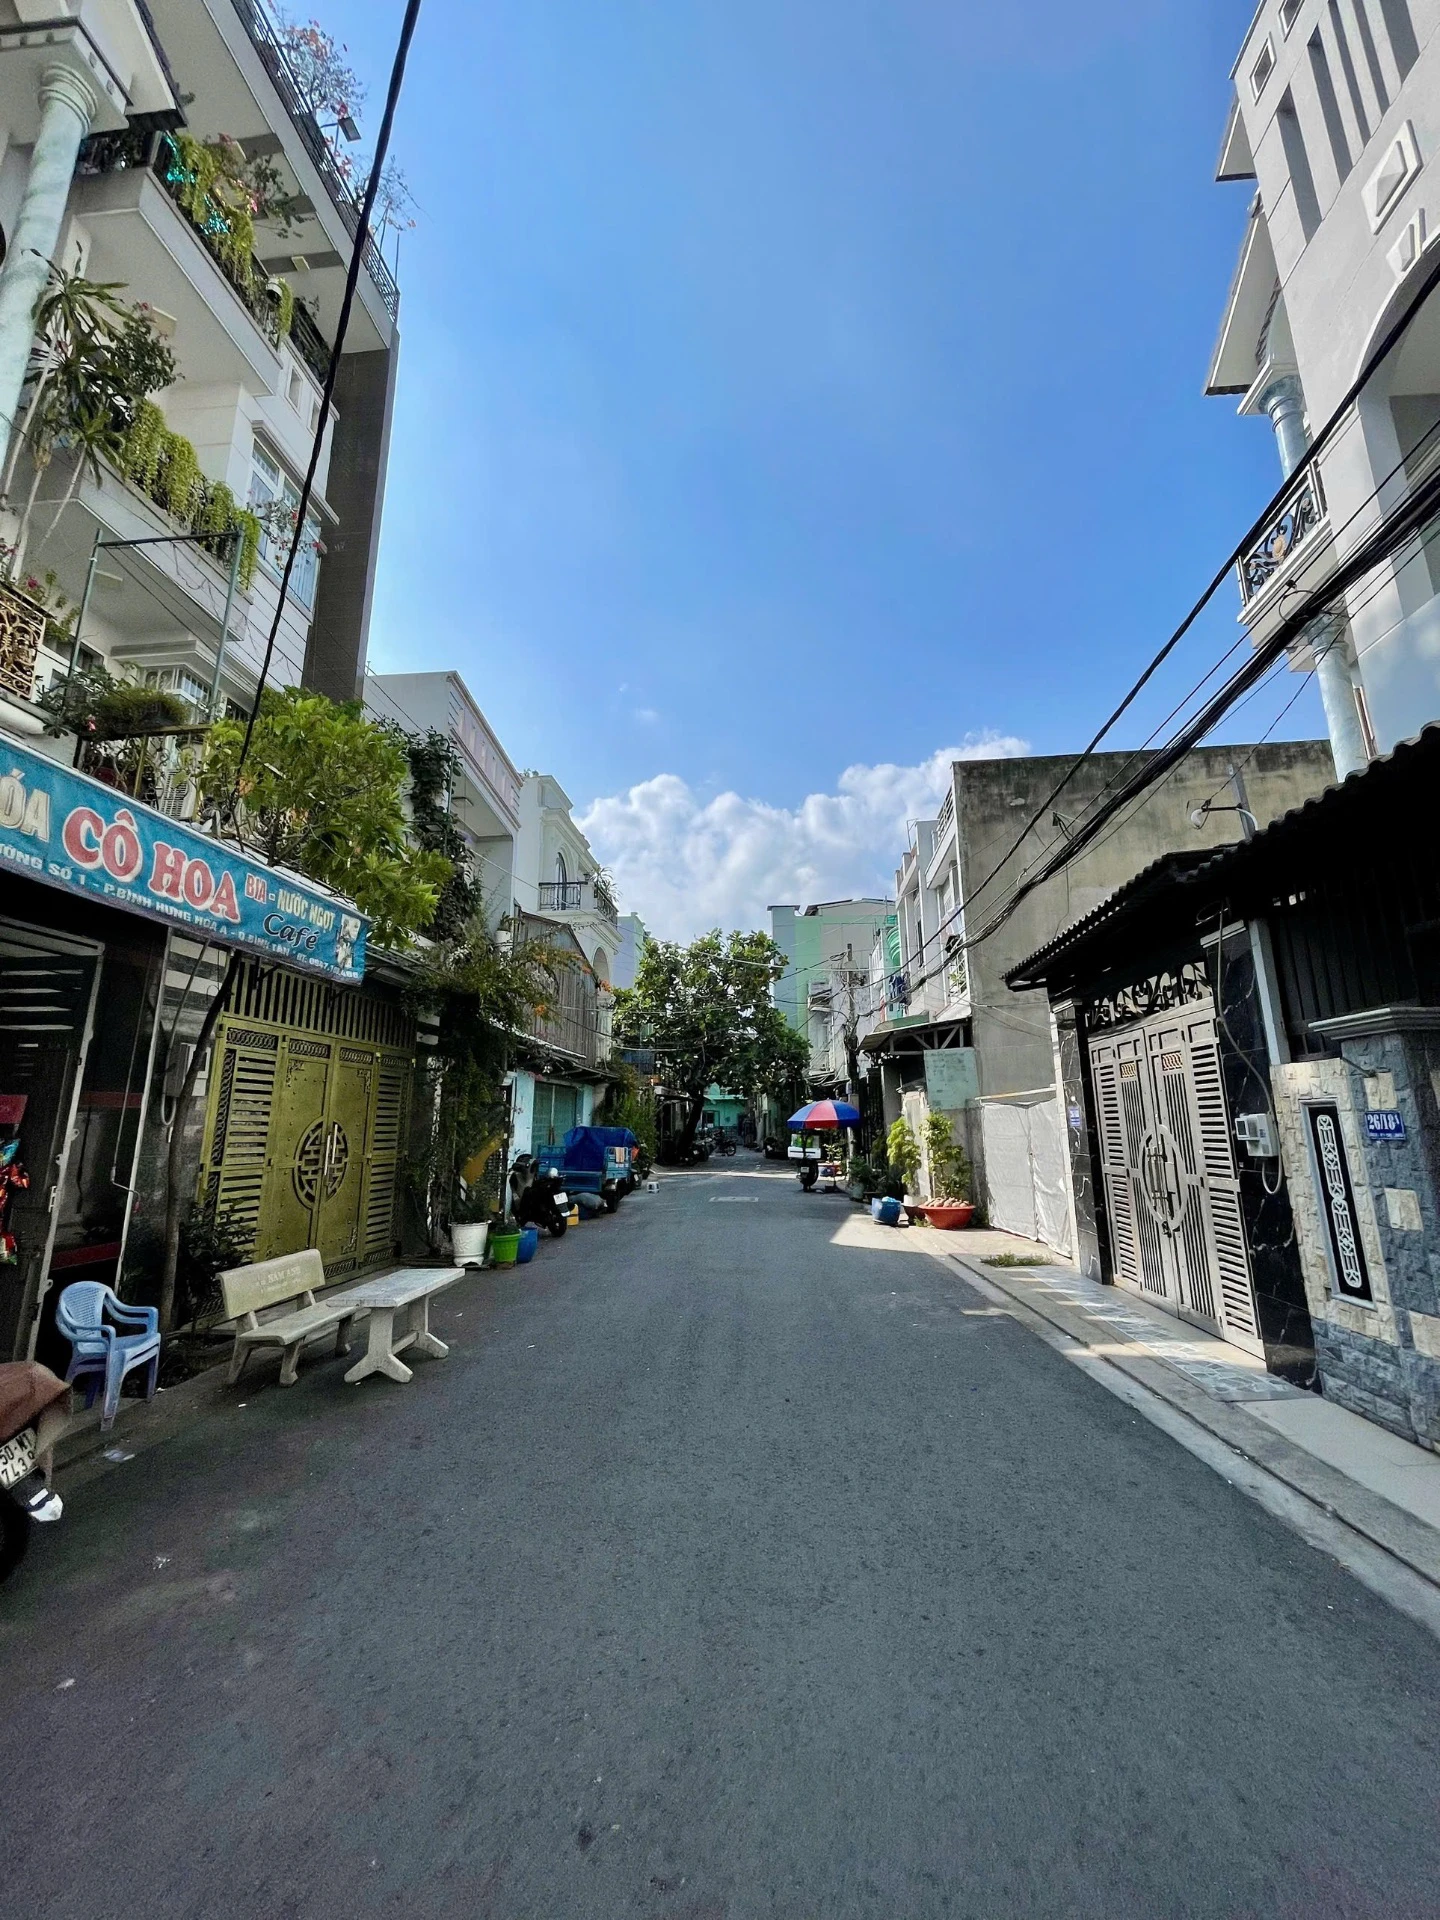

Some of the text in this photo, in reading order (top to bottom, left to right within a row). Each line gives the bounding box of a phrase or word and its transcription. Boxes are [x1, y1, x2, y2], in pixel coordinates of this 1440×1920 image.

[62, 806, 143, 882] CÔ
[148, 841, 241, 924] HOA
[245, 873, 267, 904] BIA
[277, 888, 309, 920] NƯỚC
[309, 904, 336, 934] NGỌT
[263, 913, 320, 951] Café
